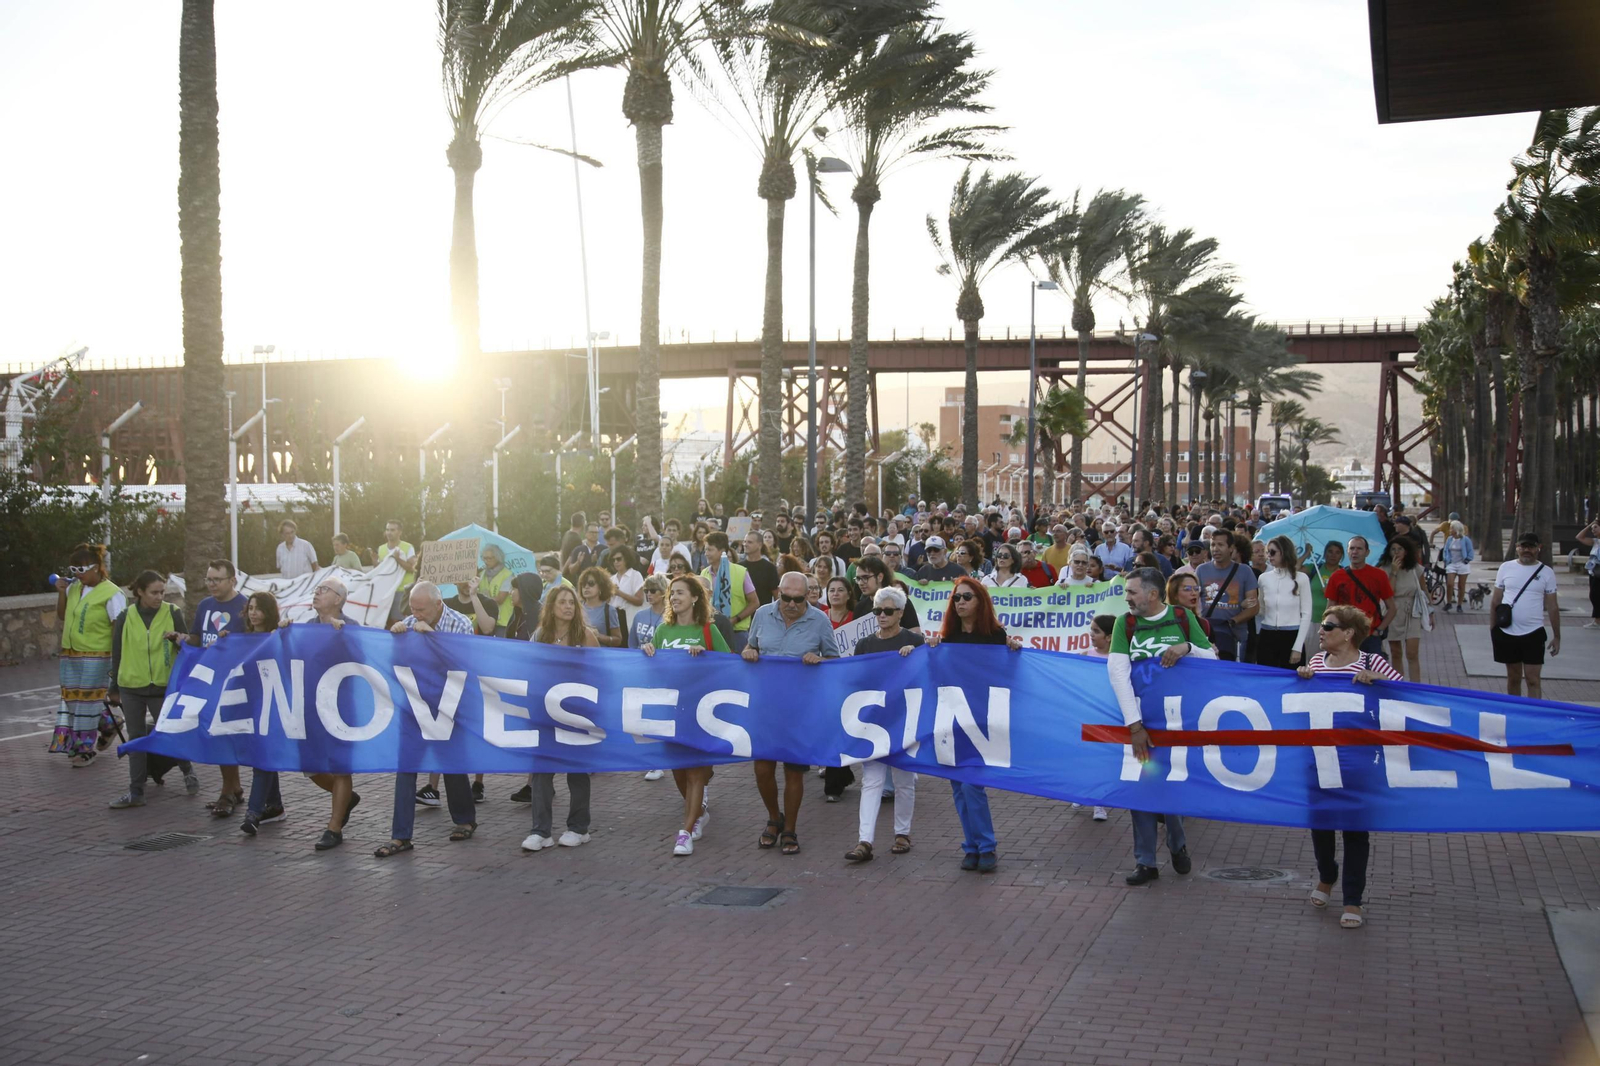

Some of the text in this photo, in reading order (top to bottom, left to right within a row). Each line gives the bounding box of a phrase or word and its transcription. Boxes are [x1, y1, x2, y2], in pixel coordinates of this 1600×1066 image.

[433, 543, 453, 552] PLAYA
[456, 541, 463, 549] DE
[466, 540, 477, 549] LOS
[423, 564, 436, 575] NO
[439, 563, 445, 573] LA
[428, 575, 437, 583] EN
[907, 583, 1124, 607] vecino ecinas del parque
[202, 610, 211, 631] I
[999, 608, 1096, 630] QUEREMOS
[636, 622, 655, 637] BEA
[1030, 635, 1061, 652] SIN
[1067, 632, 1091, 652] HO
[154, 657, 754, 758] GENOVESES
[839, 685, 1012, 769] SIN
